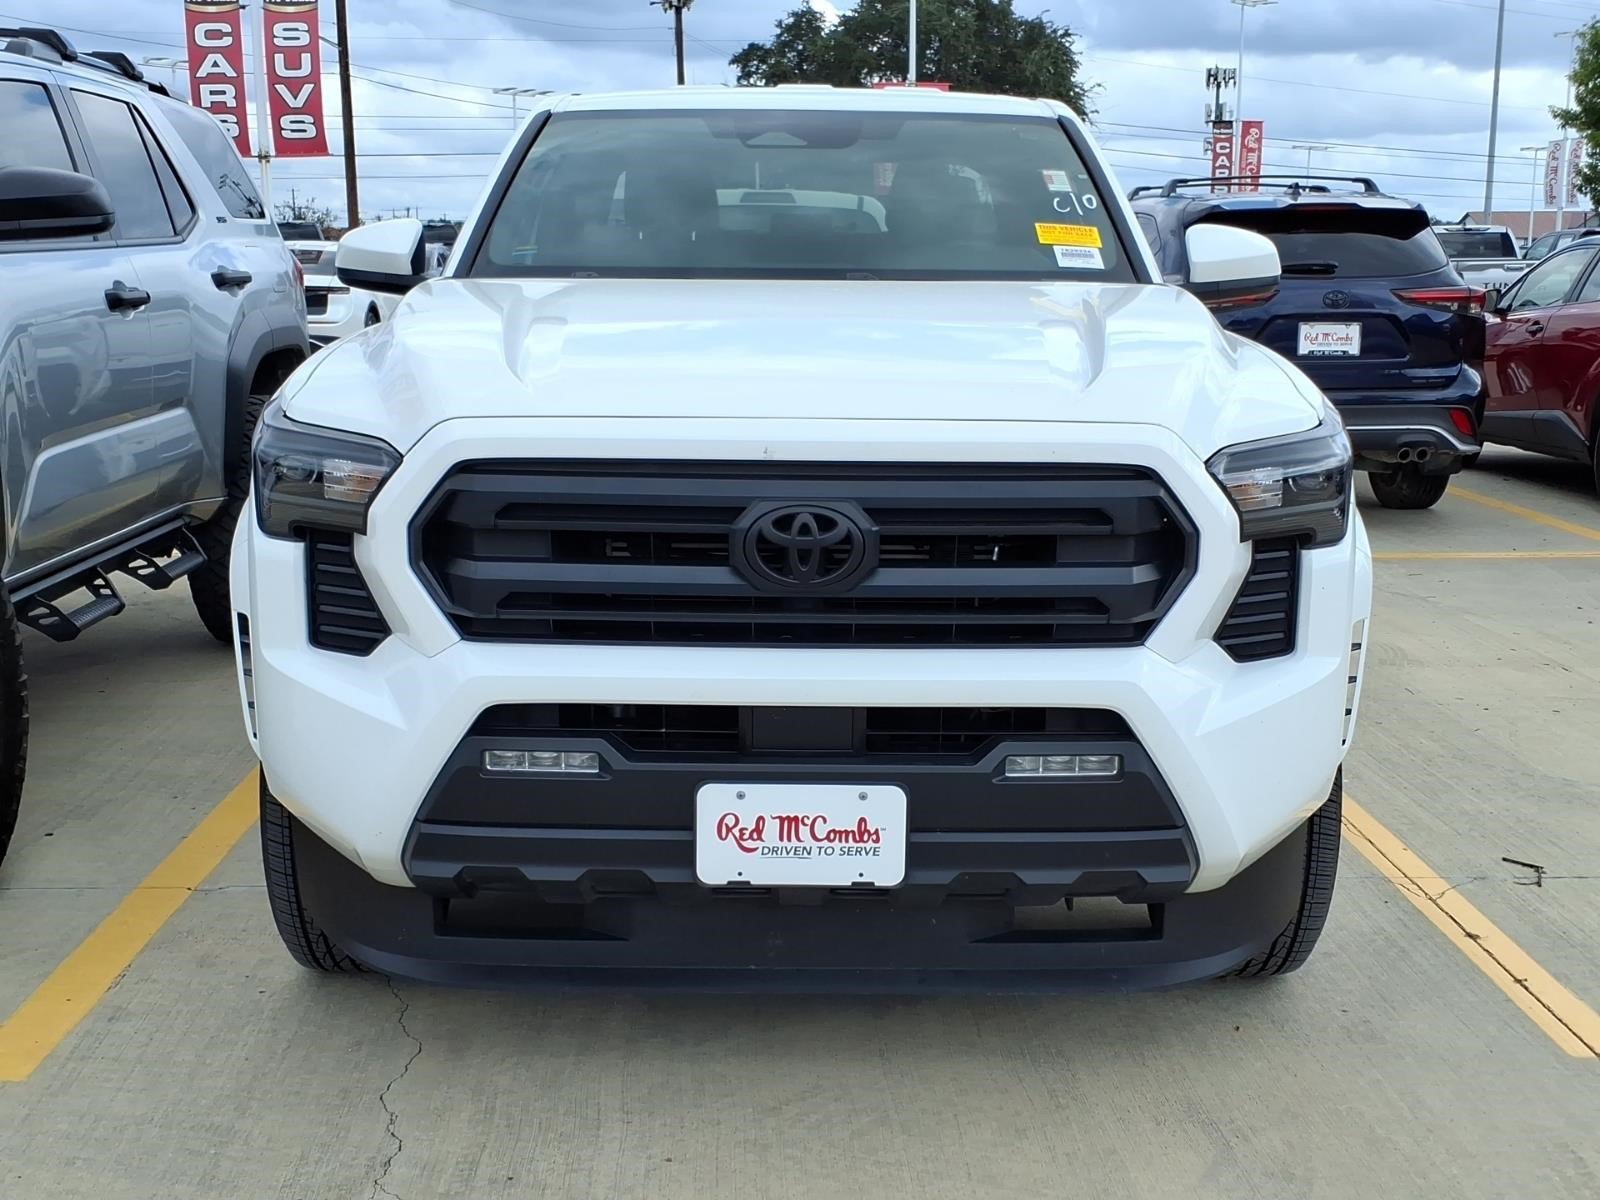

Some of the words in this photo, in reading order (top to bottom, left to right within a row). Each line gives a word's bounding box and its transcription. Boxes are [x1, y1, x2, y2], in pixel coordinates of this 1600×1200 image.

[273, 22, 317, 139] SUVS
[717, 812, 766, 853] Red
[770, 814, 881, 844] McCombs
[761, 846, 812, 857] DRIVEN
[816, 846, 835, 857] TO
[838, 846, 881, 857] SERVE
